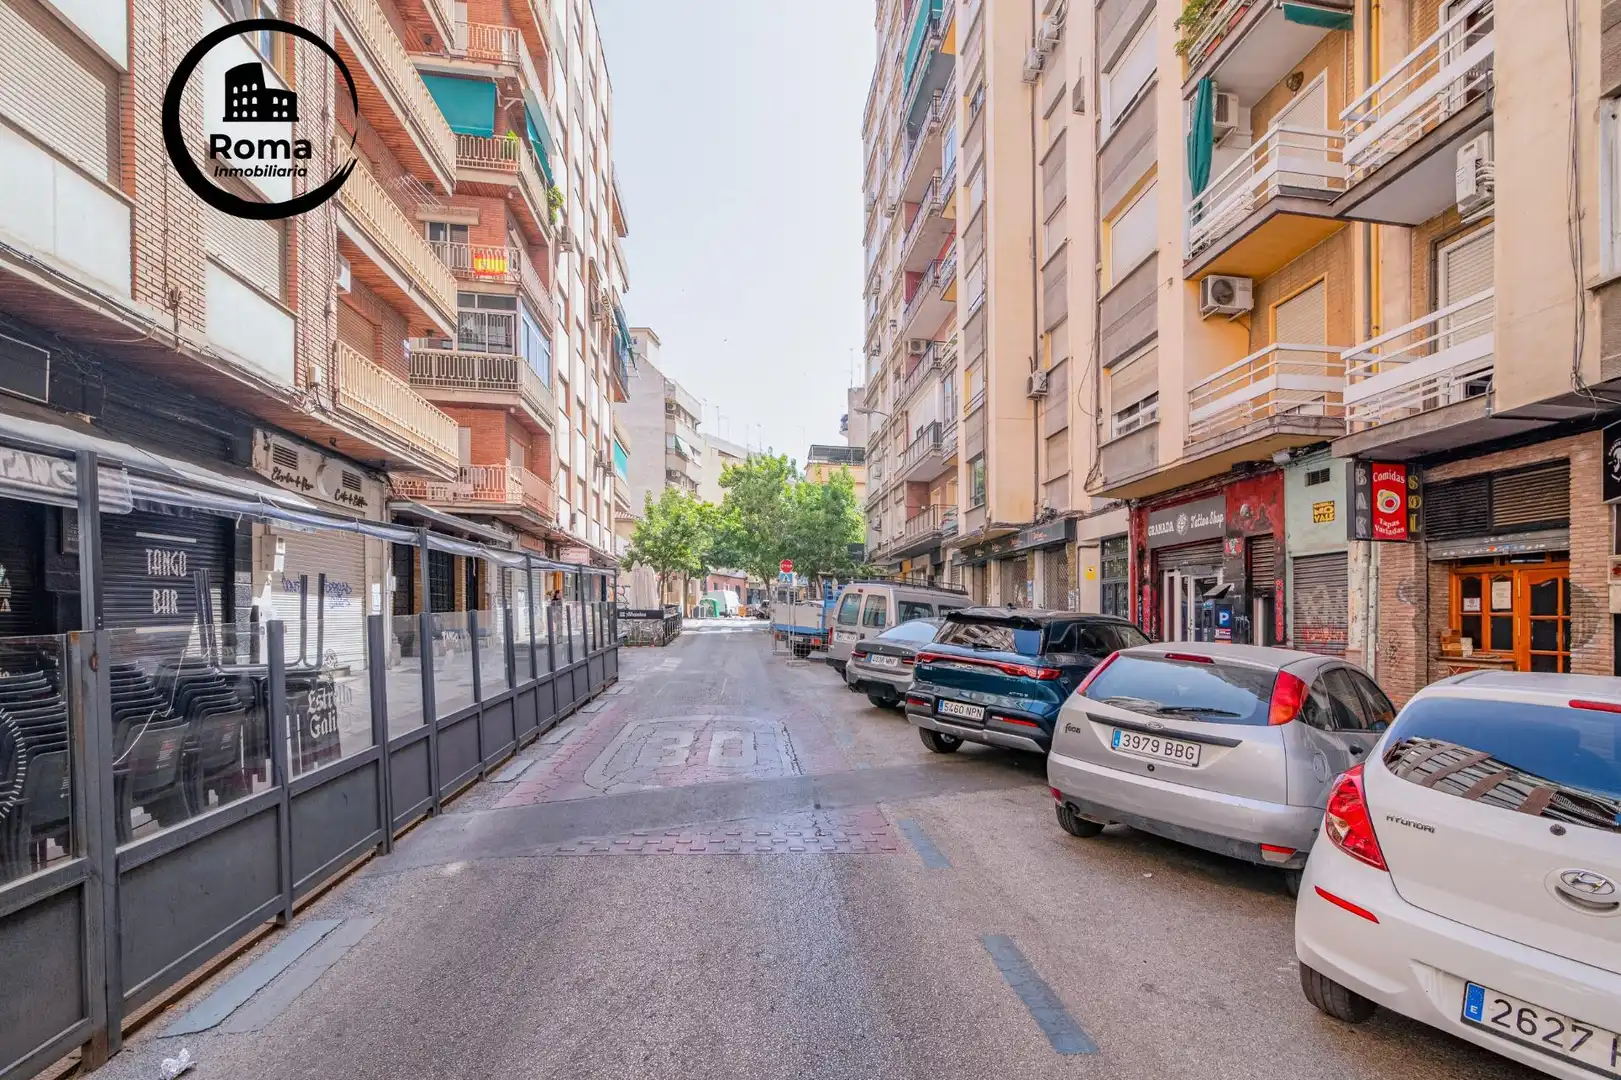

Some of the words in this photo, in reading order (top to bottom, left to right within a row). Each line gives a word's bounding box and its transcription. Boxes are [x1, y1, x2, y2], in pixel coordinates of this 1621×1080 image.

[0, 450, 77, 489] TANG
[1372, 469, 1405, 484] Comidas
[1355, 467, 1368, 538] BAR
[1148, 520, 1175, 537] GRANADA
[1209, 509, 1224, 529] Shop
[1374, 524, 1405, 536] Variadas
[1378, 517, 1400, 529] Tapas
[145, 548, 188, 577] TANGO
[153, 588, 179, 614] BAR
[1218, 612, 1230, 625] P
[944, 702, 964, 715] 5460
[966, 706, 984, 719] NPN
[1123, 734, 1160, 753] 3979
[1164, 741, 1195, 760] BBG
[1386, 814, 1436, 833] HYUNDAI
[1470, 1004, 1478, 1015] E
[1491, 998, 1594, 1052] 2627
